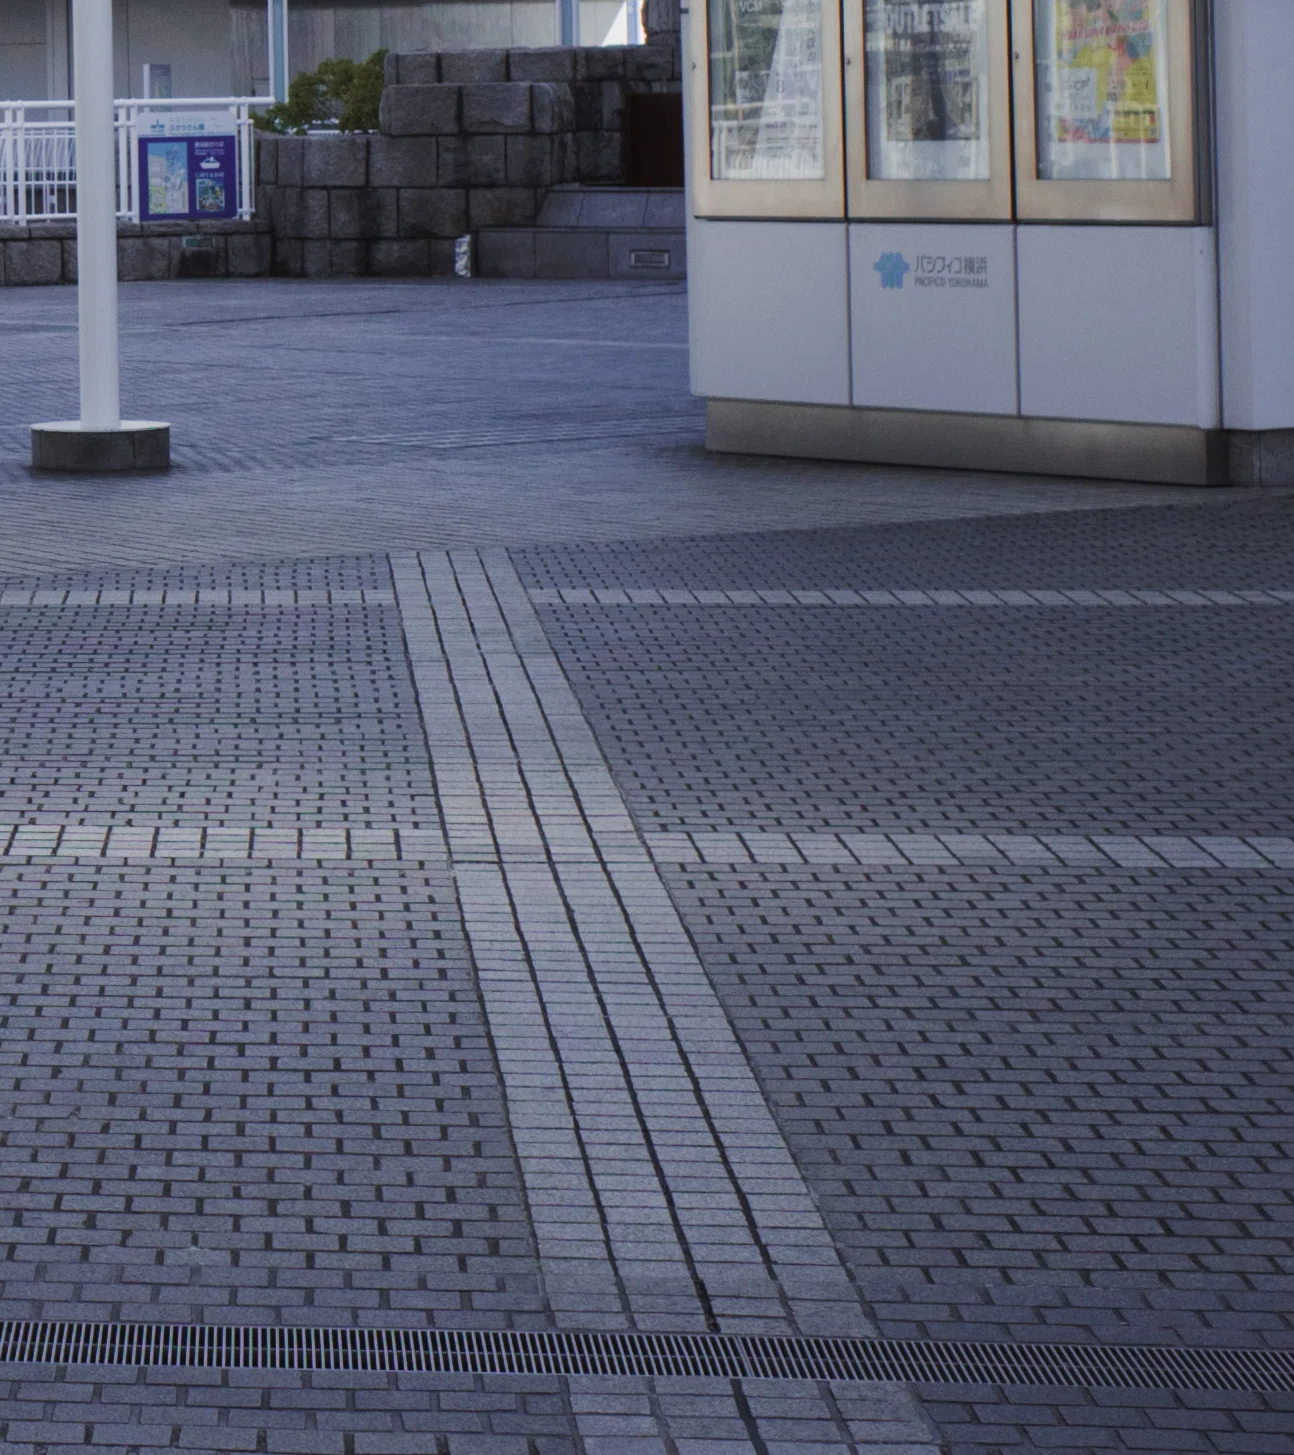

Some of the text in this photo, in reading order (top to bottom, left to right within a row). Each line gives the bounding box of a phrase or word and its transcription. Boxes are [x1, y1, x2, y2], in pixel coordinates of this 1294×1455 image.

[914, 254, 988, 275] パシフィコ横浜
